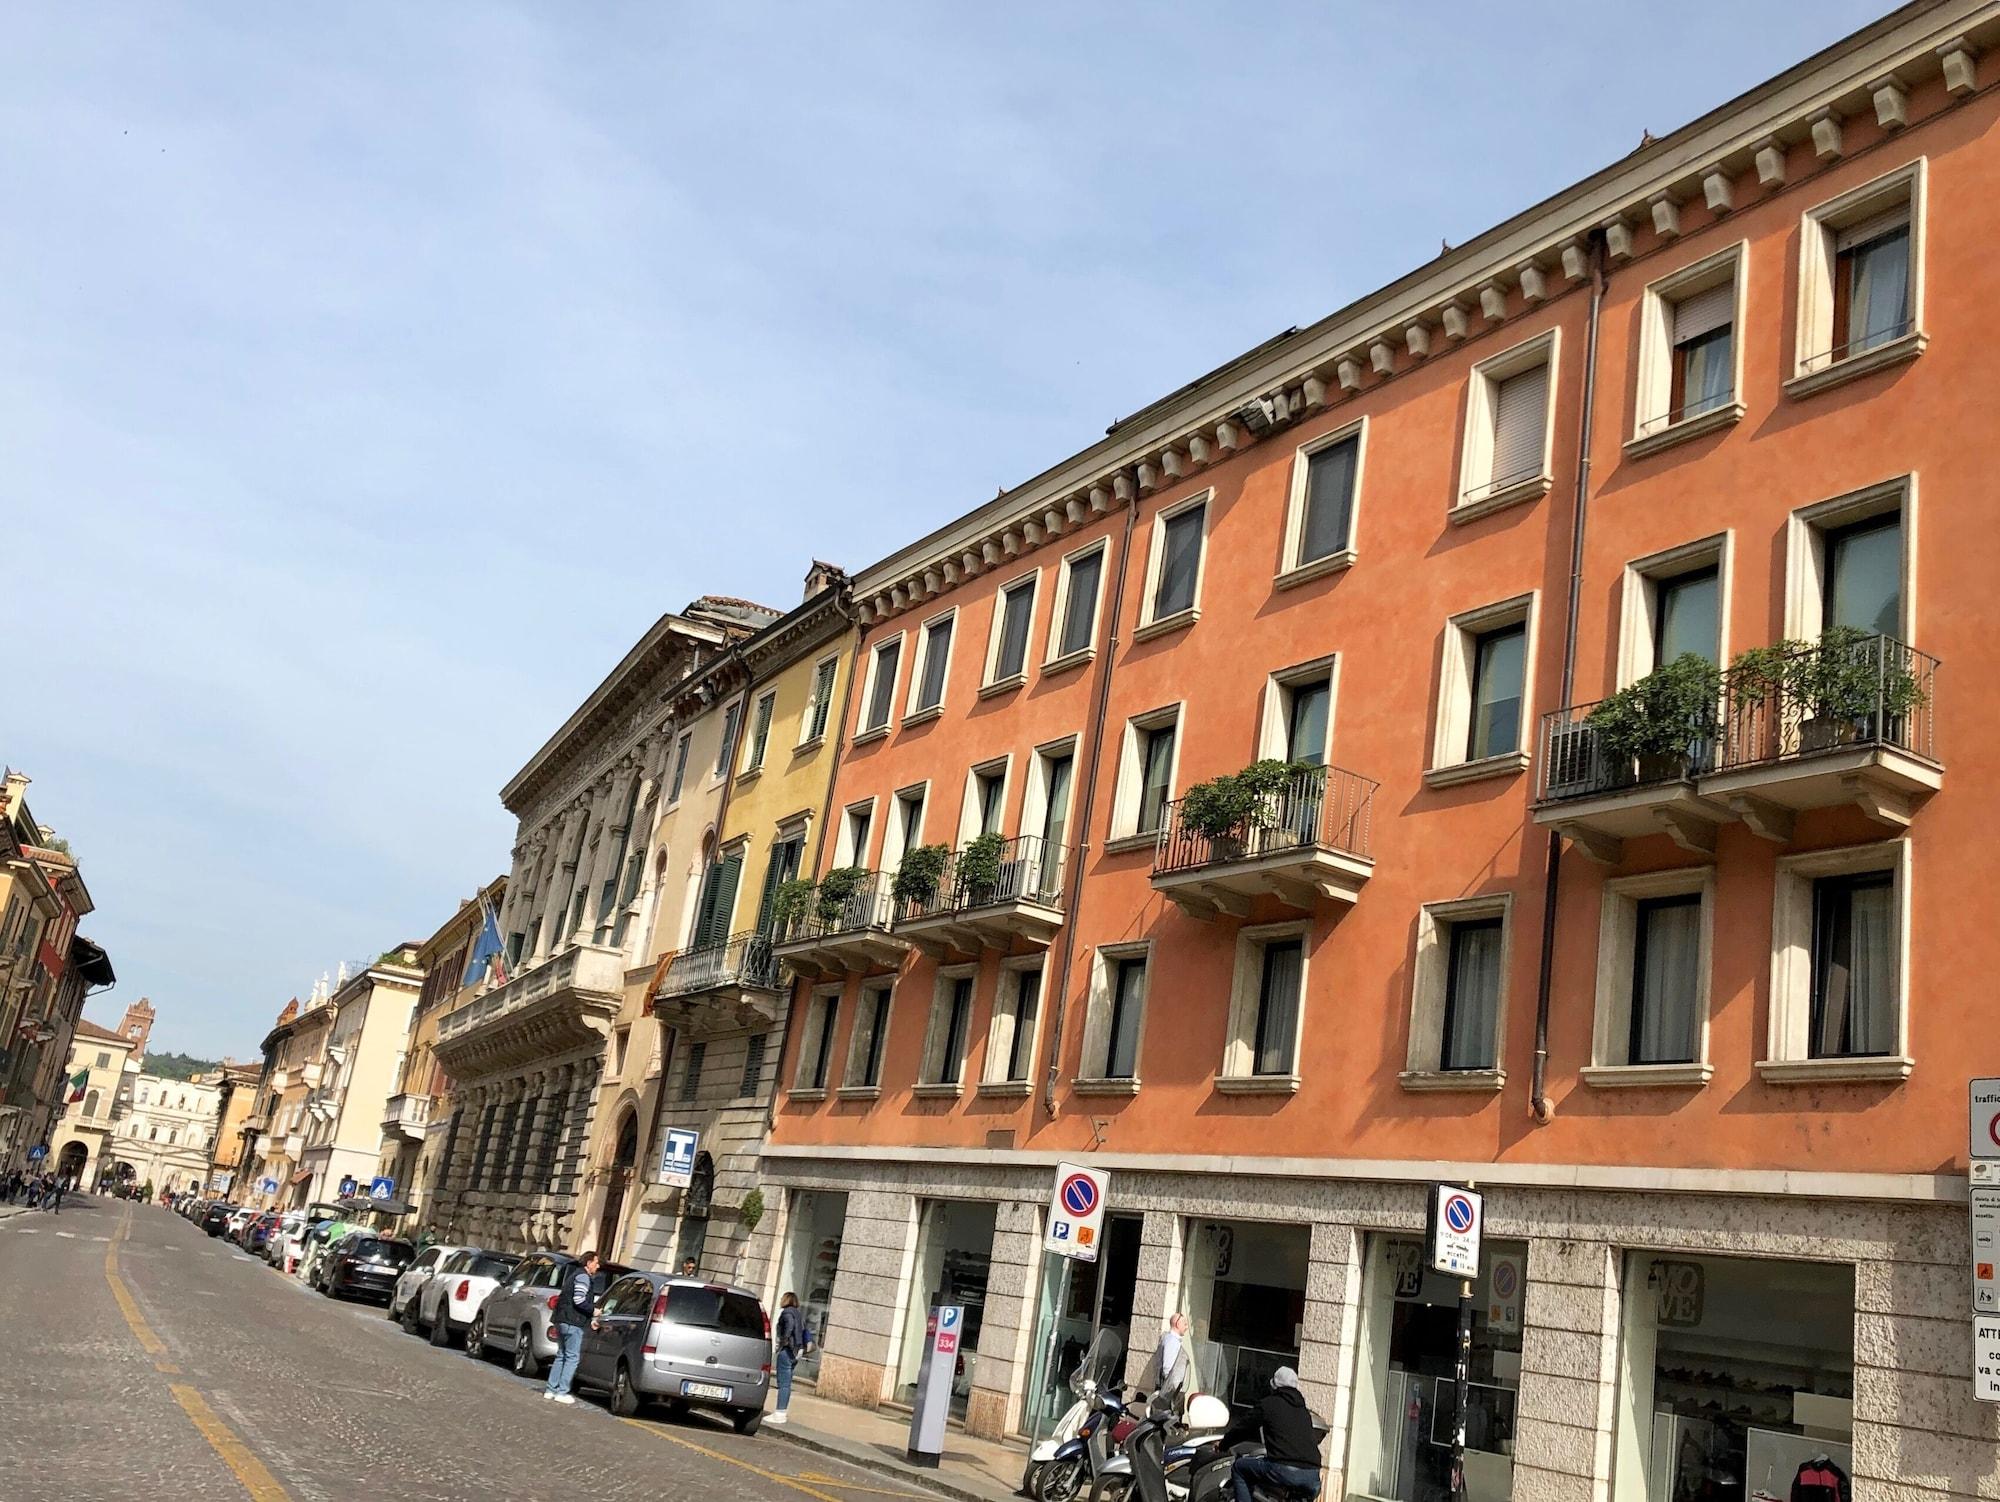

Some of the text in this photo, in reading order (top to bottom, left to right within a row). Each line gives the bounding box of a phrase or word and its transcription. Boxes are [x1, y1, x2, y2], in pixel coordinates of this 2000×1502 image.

[1056, 1223, 1066, 1237] P
[1558, 1242, 1576, 1257] 27
[943, 1308, 955, 1325] P
[938, 1338, 954, 1350] 334
